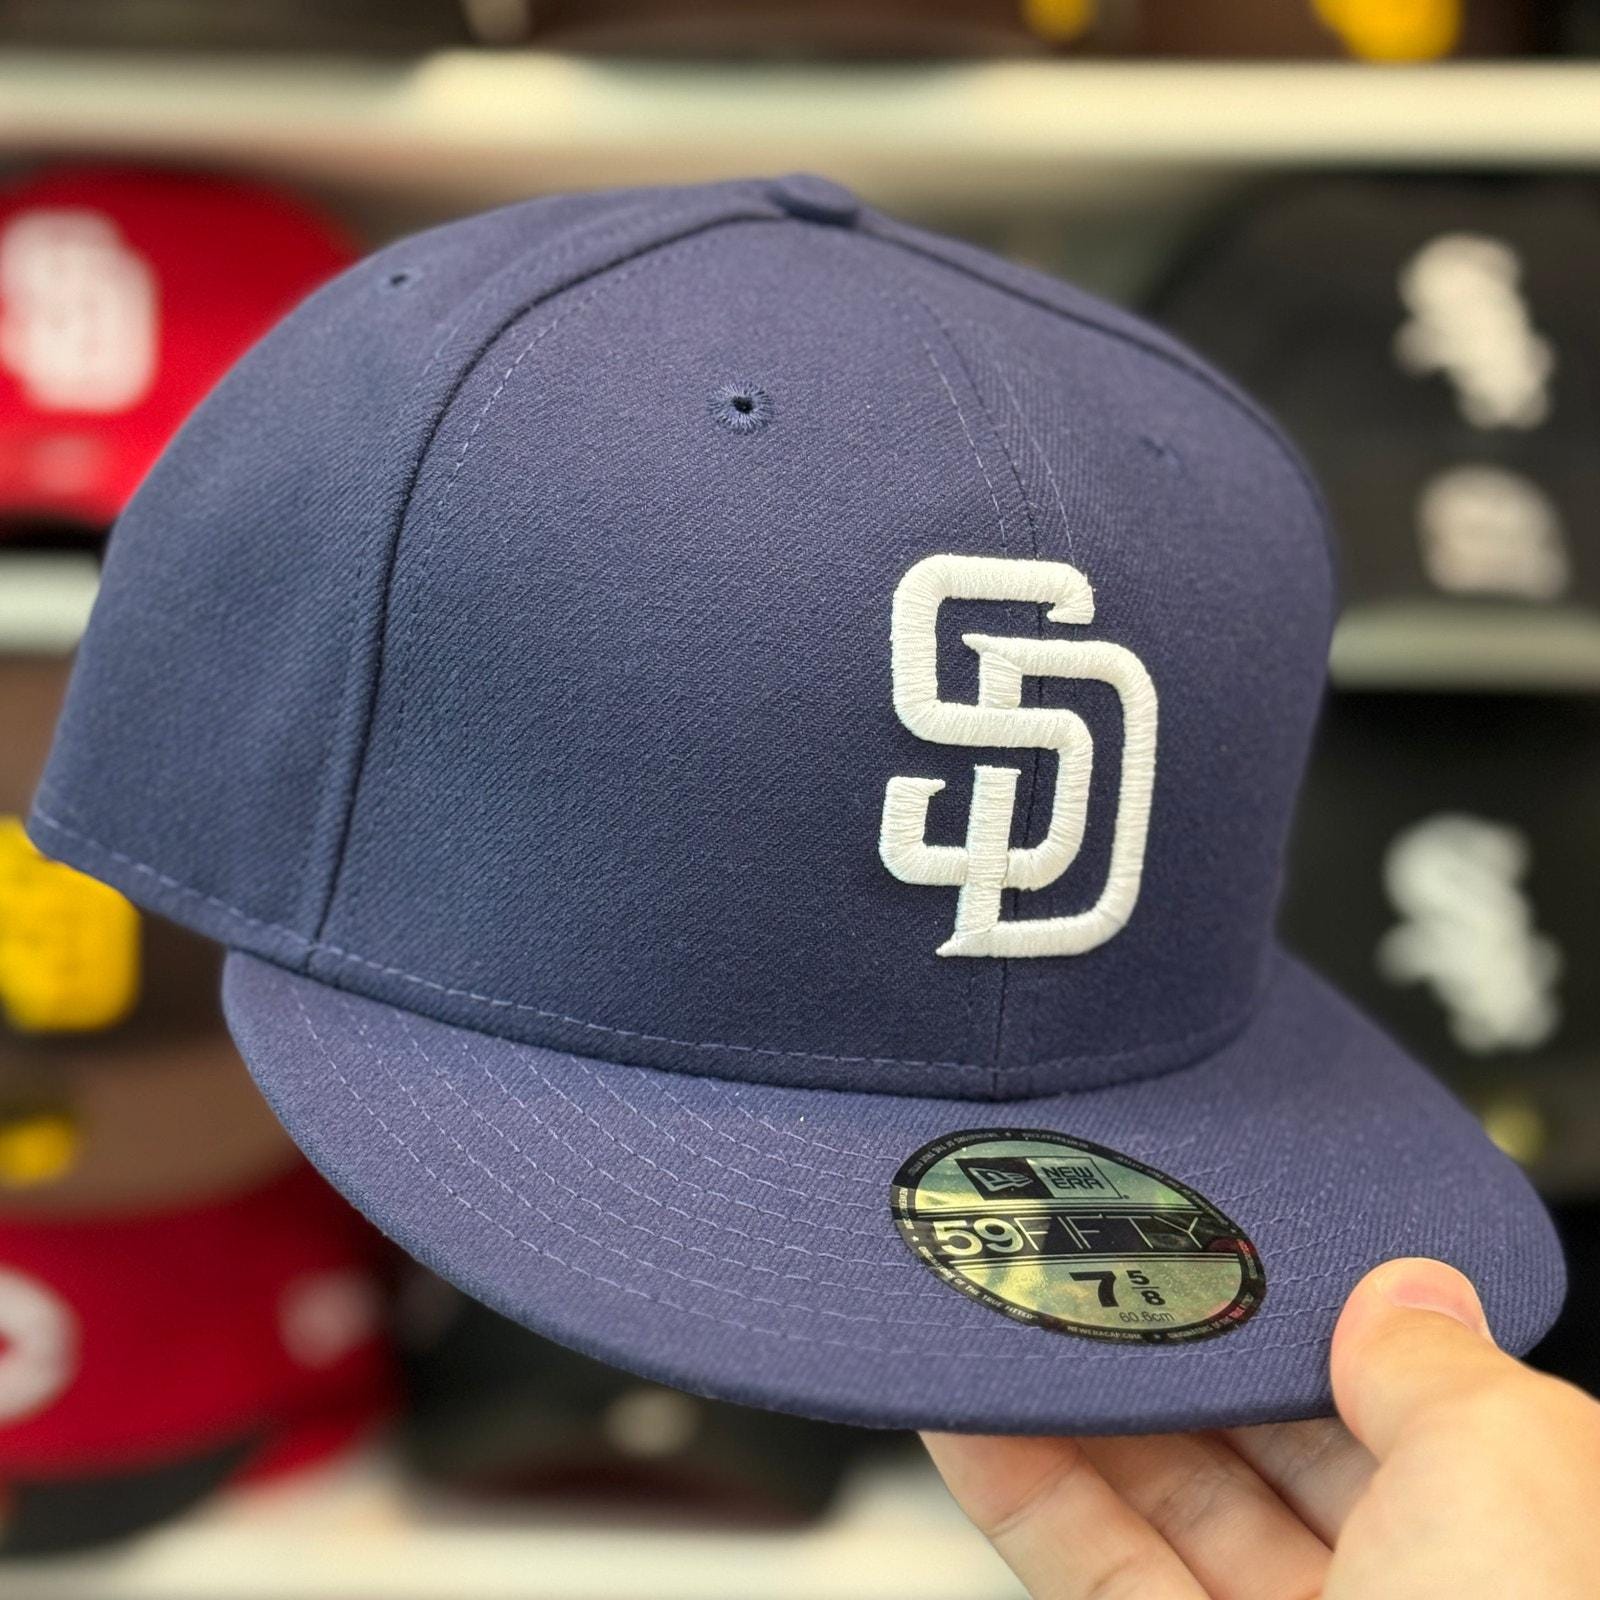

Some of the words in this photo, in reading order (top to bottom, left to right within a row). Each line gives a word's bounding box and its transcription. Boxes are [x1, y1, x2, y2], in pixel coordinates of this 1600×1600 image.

[878, 553, 1158, 959] SD
[1040, 1166, 1095, 1178] NEW
[1050, 1178, 1106, 1190] ERA
[1068, 1270, 1120, 1308] 7
[982, 1294, 1003, 1308] TRUE
